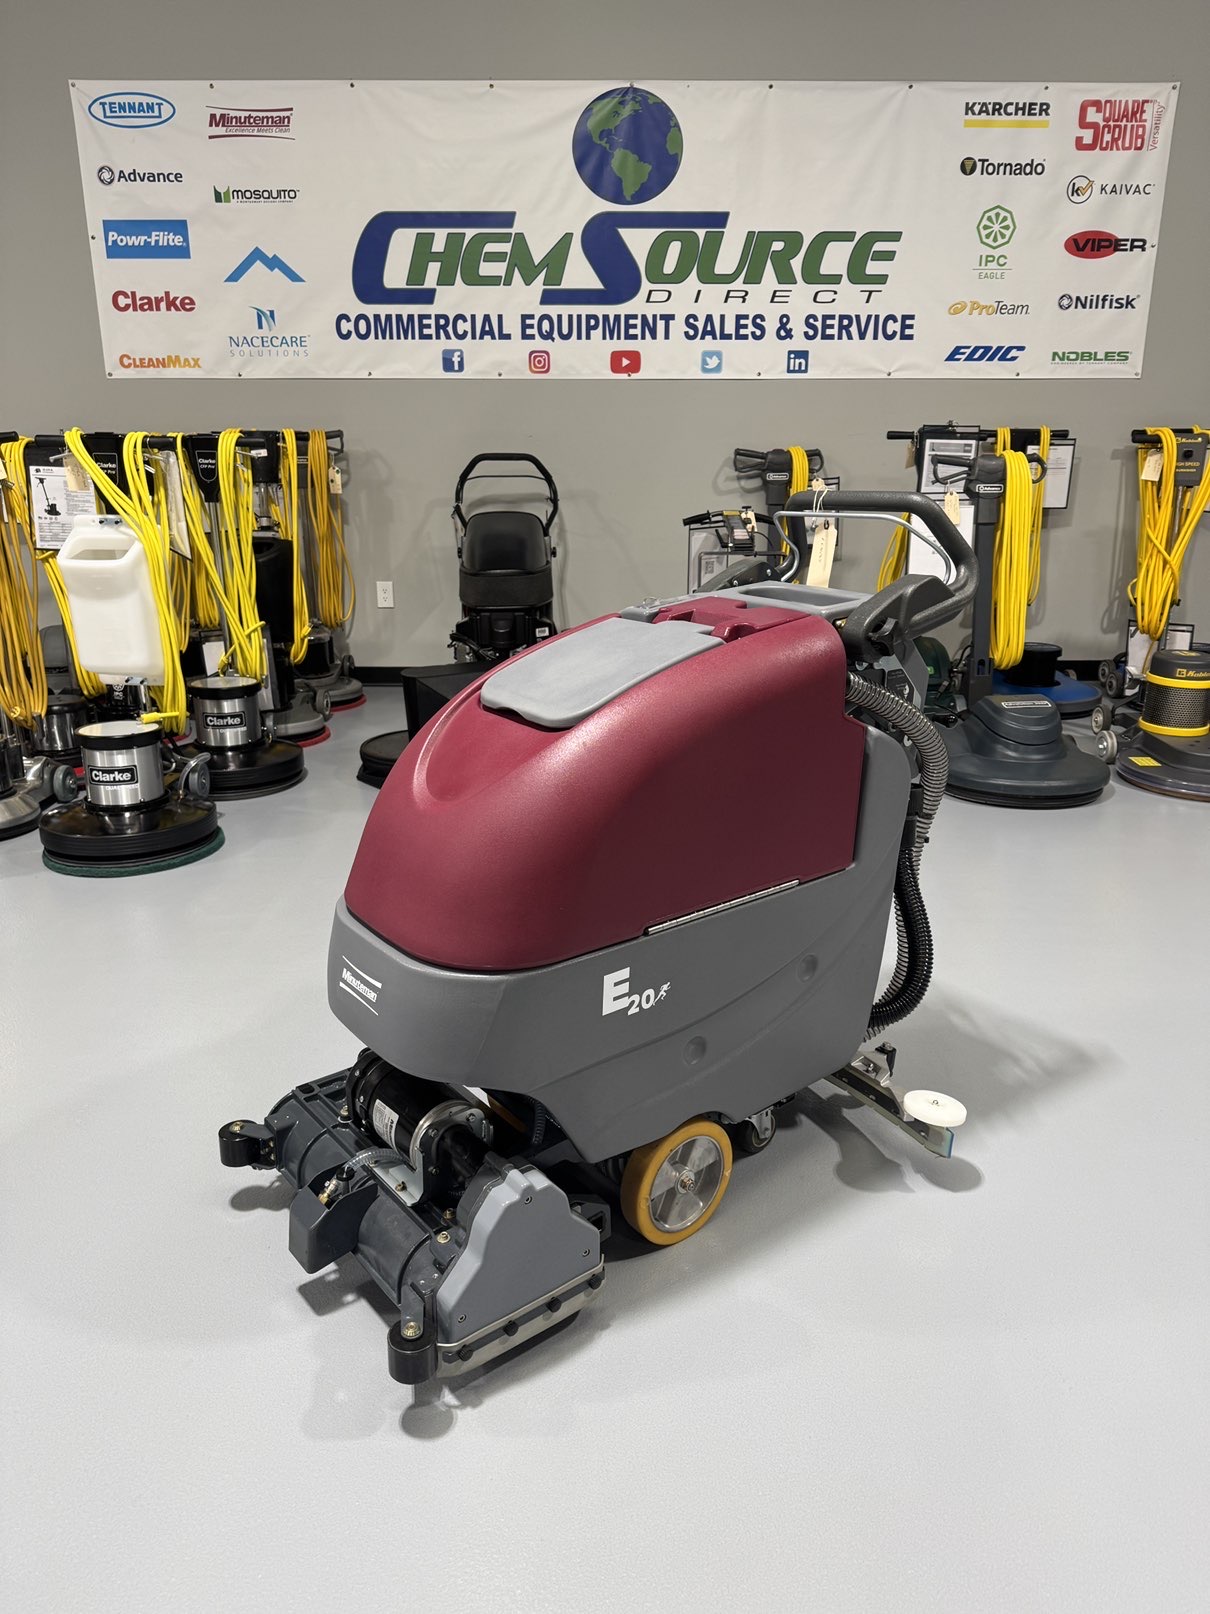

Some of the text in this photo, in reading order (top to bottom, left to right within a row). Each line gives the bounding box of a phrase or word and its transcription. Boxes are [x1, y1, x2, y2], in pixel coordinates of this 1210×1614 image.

[99, 101, 163, 118] TENNANT
[964, 101, 1050, 117] KÄRCHER
[208, 113, 291, 127] Minuteman
[1149, 104, 1165, 151] Versatility
[977, 158, 1046, 176] Tornado
[117, 169, 183, 183] Advance
[231, 189, 297, 200] MOSQUITO
[1100, 184, 1152, 195] KAIVAC
[107, 231, 184, 247] Powr-Flite
[1072, 238, 1148, 252] VIPER
[978, 254, 1008, 267] IPC
[978, 272, 1005, 280] EAGLE
[112, 290, 196, 313] Clarke
[645, 289, 883, 304] DIRECT
[1074, 294, 1137, 310] Nilfisk
[968, 300, 1030, 316] ProTeam
[335, 313, 915, 342] COMMERCIAL EQUIPMENT SALES & SERVICE
[229, 336, 307, 348] NACECARE
[944, 345, 1026, 362] EDIC
[1051, 351, 1130, 361] NOBLES
[206, 716, 241, 726] Clarke
[92, 770, 132, 781] Clarke
[341, 967, 378, 1003] Minuteman
